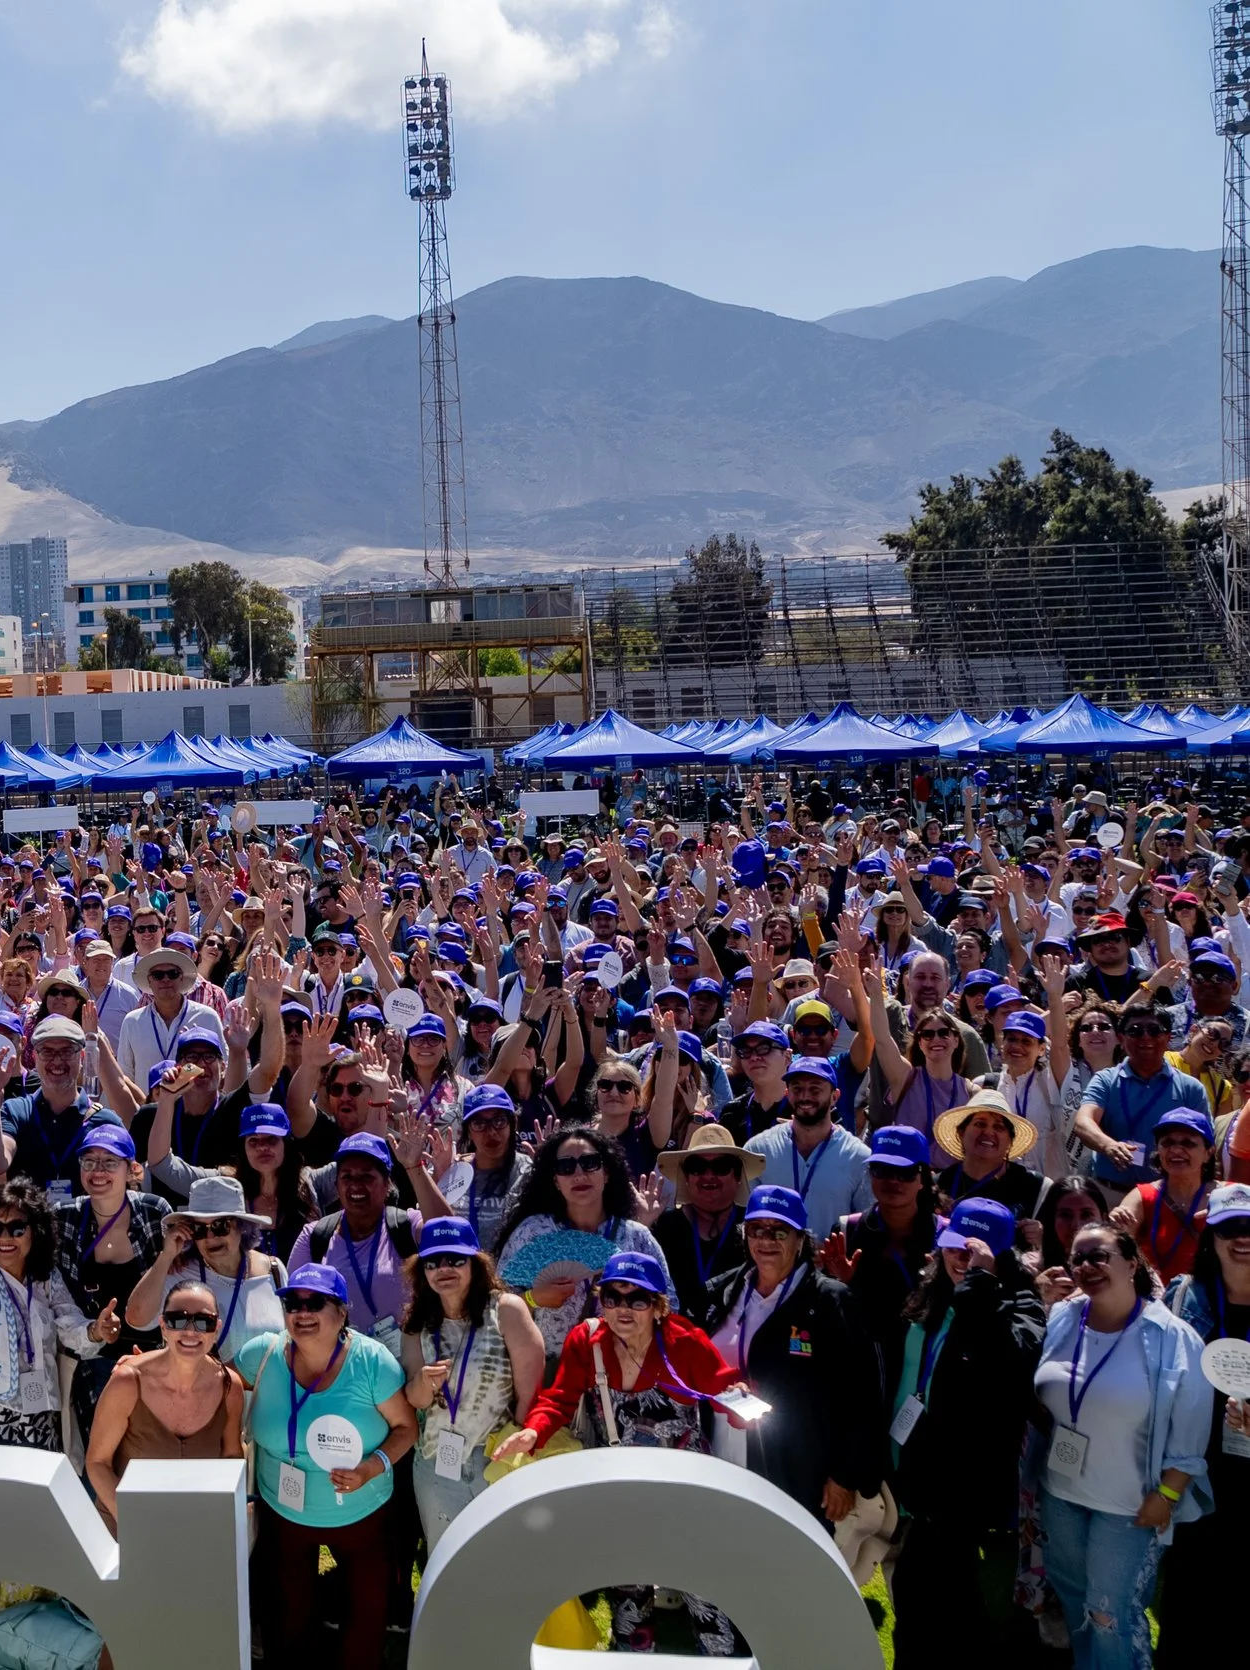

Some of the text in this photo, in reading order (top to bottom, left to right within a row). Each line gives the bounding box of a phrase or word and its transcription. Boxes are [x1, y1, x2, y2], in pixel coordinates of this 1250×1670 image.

[397, 1000, 416, 1011] envis
[257, 1113, 274, 1121] envis
[355, 1140, 373, 1148] envis
[883, 1136, 901, 1145] envis
[769, 1196, 789, 1208] envis
[969, 1219, 990, 1231] envis
[440, 1229, 460, 1237] envis
[625, 1262, 645, 1272] envis
[301, 1271, 321, 1279] envis
[326, 1434, 351, 1444] envis
